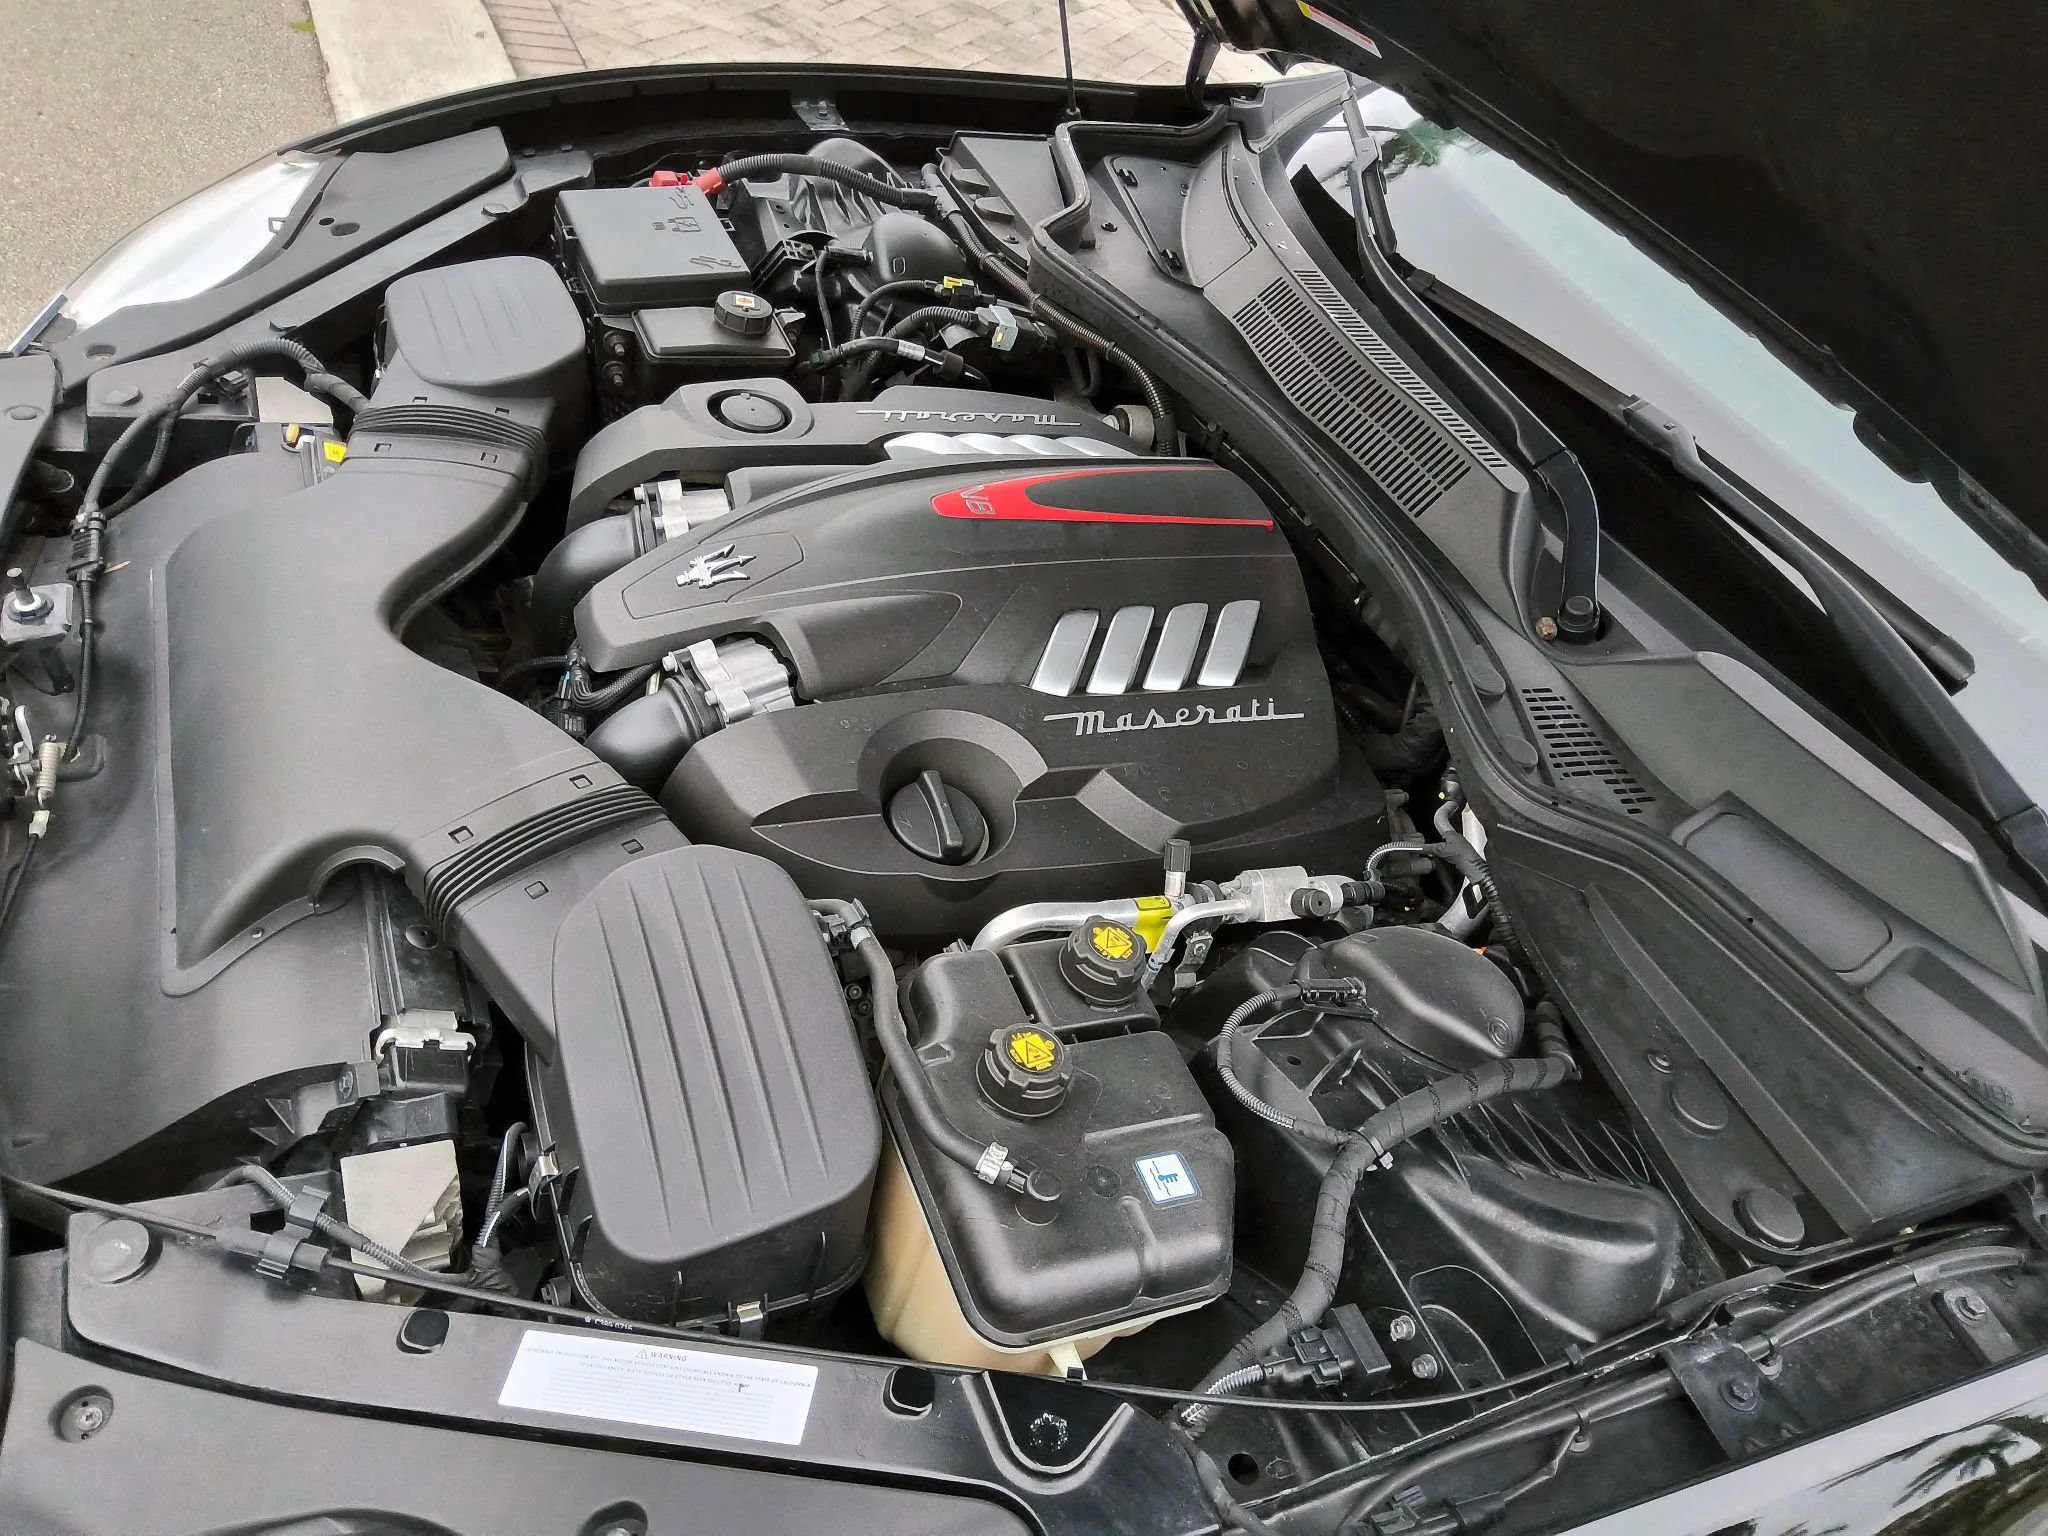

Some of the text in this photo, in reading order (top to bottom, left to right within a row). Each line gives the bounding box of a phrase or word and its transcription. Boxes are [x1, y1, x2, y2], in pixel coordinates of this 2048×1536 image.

[856, 410, 1081, 426] Maserati
[960, 485, 996, 515] V8
[1043, 697, 1305, 736] Maserati
[651, 1351, 687, 1362] WARNING
